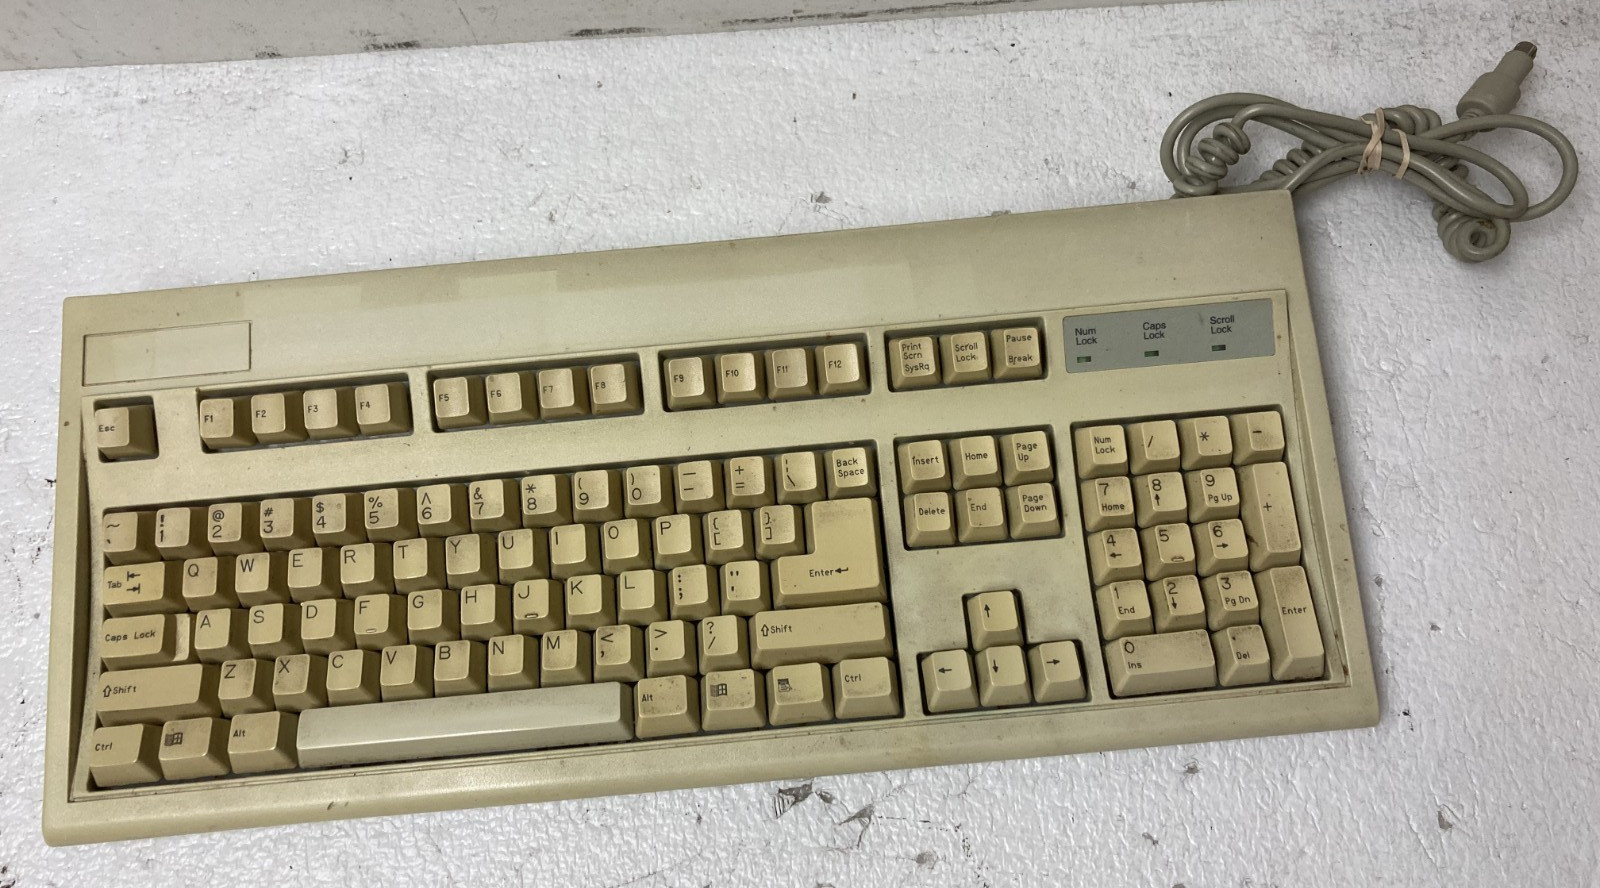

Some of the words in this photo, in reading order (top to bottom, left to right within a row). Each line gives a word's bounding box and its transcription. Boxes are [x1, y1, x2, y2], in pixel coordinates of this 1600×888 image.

[1210, 315, 1235, 325] Scroll
[1075, 327, 1097, 337] Num
[1142, 321, 1167, 332] Caps
[1210, 325, 1233, 335] Lock
[1006, 334, 1033, 343] Pause
[1076, 337, 1098, 346] Lock
[1143, 331, 1166, 341] Lock
[902, 342, 922, 352] Print
[955, 342, 978, 352] Scroll
[903, 352, 923, 360] Scrn
[956, 354, 976, 363] Lock
[1008, 354, 1033, 363] Break
[777, 366, 788, 374] F11
[828, 361, 842, 369] F12
[905, 363, 930, 373] SysRq
[673, 374, 685, 383] F9
[725, 370, 739, 378] F10
[543, 385, 554, 394] F7
[595, 381, 606, 390] F8
[438, 394, 450, 402] F5
[490, 390, 502, 398] F6
[307, 404, 319, 413] F3
[359, 401, 371, 411] F4
[204, 415, 214, 423] F1
[255, 410, 267, 419] F2
[98, 425, 116, 433] Esc
[1094, 436, 1112, 444] Num
[1148, 435, 1154, 449] /
[1016, 442, 1038, 452] Page
[1095, 446, 1116, 454] Lock
[912, 456, 940, 466] Insert
[965, 452, 989, 461] Home
[1018, 453, 1030, 463] Up
[836, 458, 859, 468] Back
[735, 466, 745, 476] +
[838, 467, 865, 479] Space
[578, 477, 583, 490] (
[630, 473, 636, 486] )
[1152, 479, 1162, 492] 8
[1205, 474, 1216, 487] 9
[473, 487, 484, 500] &
[632, 488, 642, 501] 0
[1098, 483, 1109, 496] 7
[368, 497, 384, 509] %
[527, 498, 537, 511] 8
[579, 492, 590, 506] 9
[1022, 494, 1044, 503] Page
[1208, 494, 1220, 504] Pg
[1221, 493, 1233, 503] Up
[264, 507, 274, 518] #
[316, 502, 325, 514] $
[473, 503, 485, 516] 7
[918, 507, 946, 516] Delete
[971, 503, 987, 512] End
[1024, 504, 1048, 513] Down
[1101, 502, 1126, 512] Home
[1263, 502, 1273, 512] +
[212, 510, 226, 522] @
[368, 511, 380, 525] 5
[421, 507, 432, 520] 6
[263, 521, 274, 534] 3
[316, 516, 327, 529] 4
[660, 521, 672, 535] P
[159, 530, 165, 543] 1
[212, 525, 223, 539] 2
[608, 526, 620, 540] O
[765, 527, 772, 540] ]
[1159, 530, 1170, 543] 5
[1213, 525, 1224, 538] 6
[502, 536, 515, 550] U
[714, 532, 722, 546] [
[1106, 534, 1117, 547] 4
[398, 545, 410, 559] T
[451, 540, 461, 554] Y
[292, 554, 304, 568] E
[344, 550, 357, 565] R
[188, 563, 200, 578] Q
[240, 558, 255, 574] W
[809, 568, 834, 578] Enter
[107, 580, 122, 590] Tab
[571, 581, 584, 595] K
[624, 576, 636, 590] L
[1167, 582, 1179, 595] 2
[1221, 577, 1232, 591] 3
[465, 590, 477, 604] H
[518, 585, 531, 599] J
[1114, 586, 1120, 600] 1
[412, 595, 425, 609] G
[1225, 597, 1237, 607] Pg
[1239, 596, 1251, 604] Dn
[306, 605, 318, 620] D
[358, 601, 371, 616] F
[1118, 606, 1136, 615] End
[1282, 606, 1308, 615] Enter
[200, 615, 212, 629] A
[253, 610, 265, 625] S
[654, 628, 668, 639] >
[706, 621, 715, 635] ?
[770, 624, 793, 635] Shift
[105, 632, 128, 643] Caps
[134, 630, 156, 640] Lock
[600, 633, 614, 644] <
[493, 641, 505, 655] N
[546, 636, 561, 650] M
[708, 637, 716, 650] /
[1124, 642, 1135, 654] 0
[386, 651, 397, 665] V
[440, 646, 451, 660] B
[1237, 651, 1251, 660] Del
[278, 660, 291, 674] X
[332, 655, 345, 669] C
[1128, 661, 1143, 670] Ins
[224, 665, 236, 679] Z
[844, 673, 862, 684] Ctrl
[113, 685, 138, 695] Shift
[641, 693, 654, 703] Alt
[233, 729, 246, 738] Alt
[95, 742, 113, 752] Ctrl
